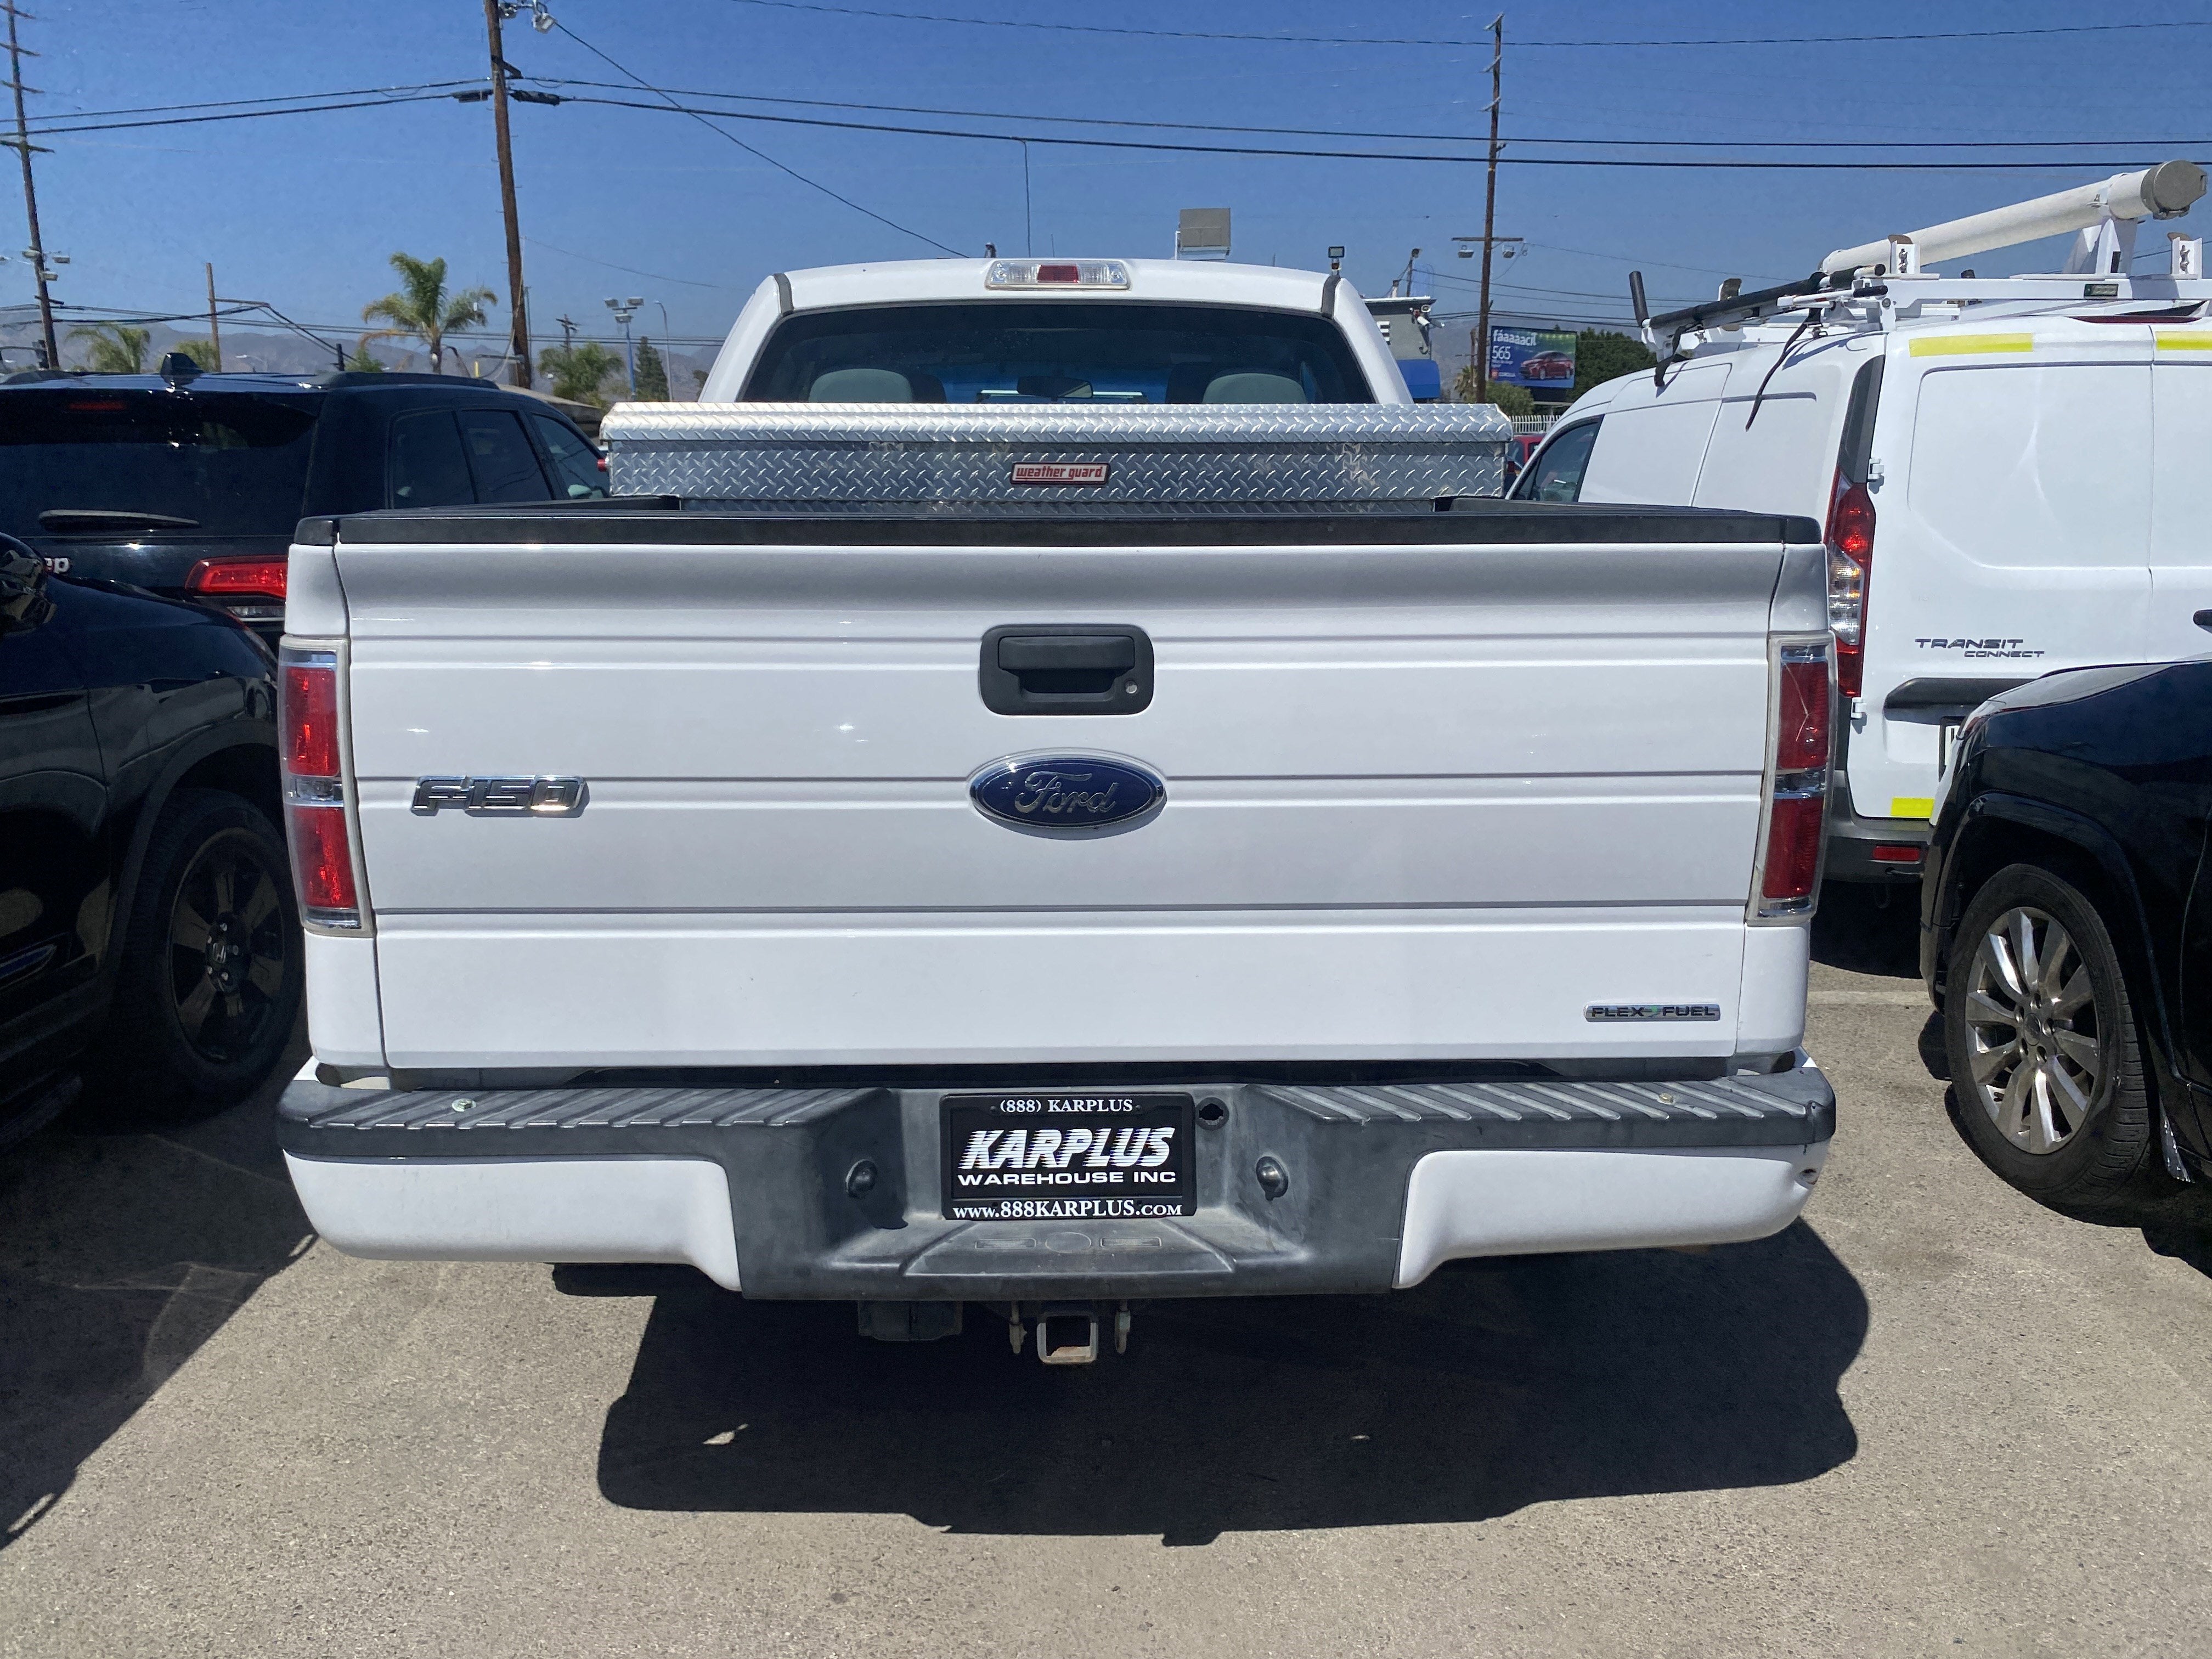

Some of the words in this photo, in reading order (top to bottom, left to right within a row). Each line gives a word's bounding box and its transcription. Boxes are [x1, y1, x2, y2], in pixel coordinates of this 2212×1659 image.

[1492, 346, 1511, 360] 565
[1016, 466, 1067, 477] weather
[1068, 466, 1103, 479] guard
[1915, 638, 2023, 649] TRANSIT
[411, 774, 589, 817] F-150
[1014, 770, 1119, 814] Ford
[1592, 1007, 1645, 1017] FLEX
[1662, 1006, 1716, 1017] FUEL
[1000, 1099, 1042, 1113] (888)
[1047, 1099, 1133, 1113] KARPLUS
[957, 1127, 1176, 1169] KARPLUS
[957, 1171, 1124, 1186] WAREHOUSE
[1133, 1171, 1176, 1183] INC
